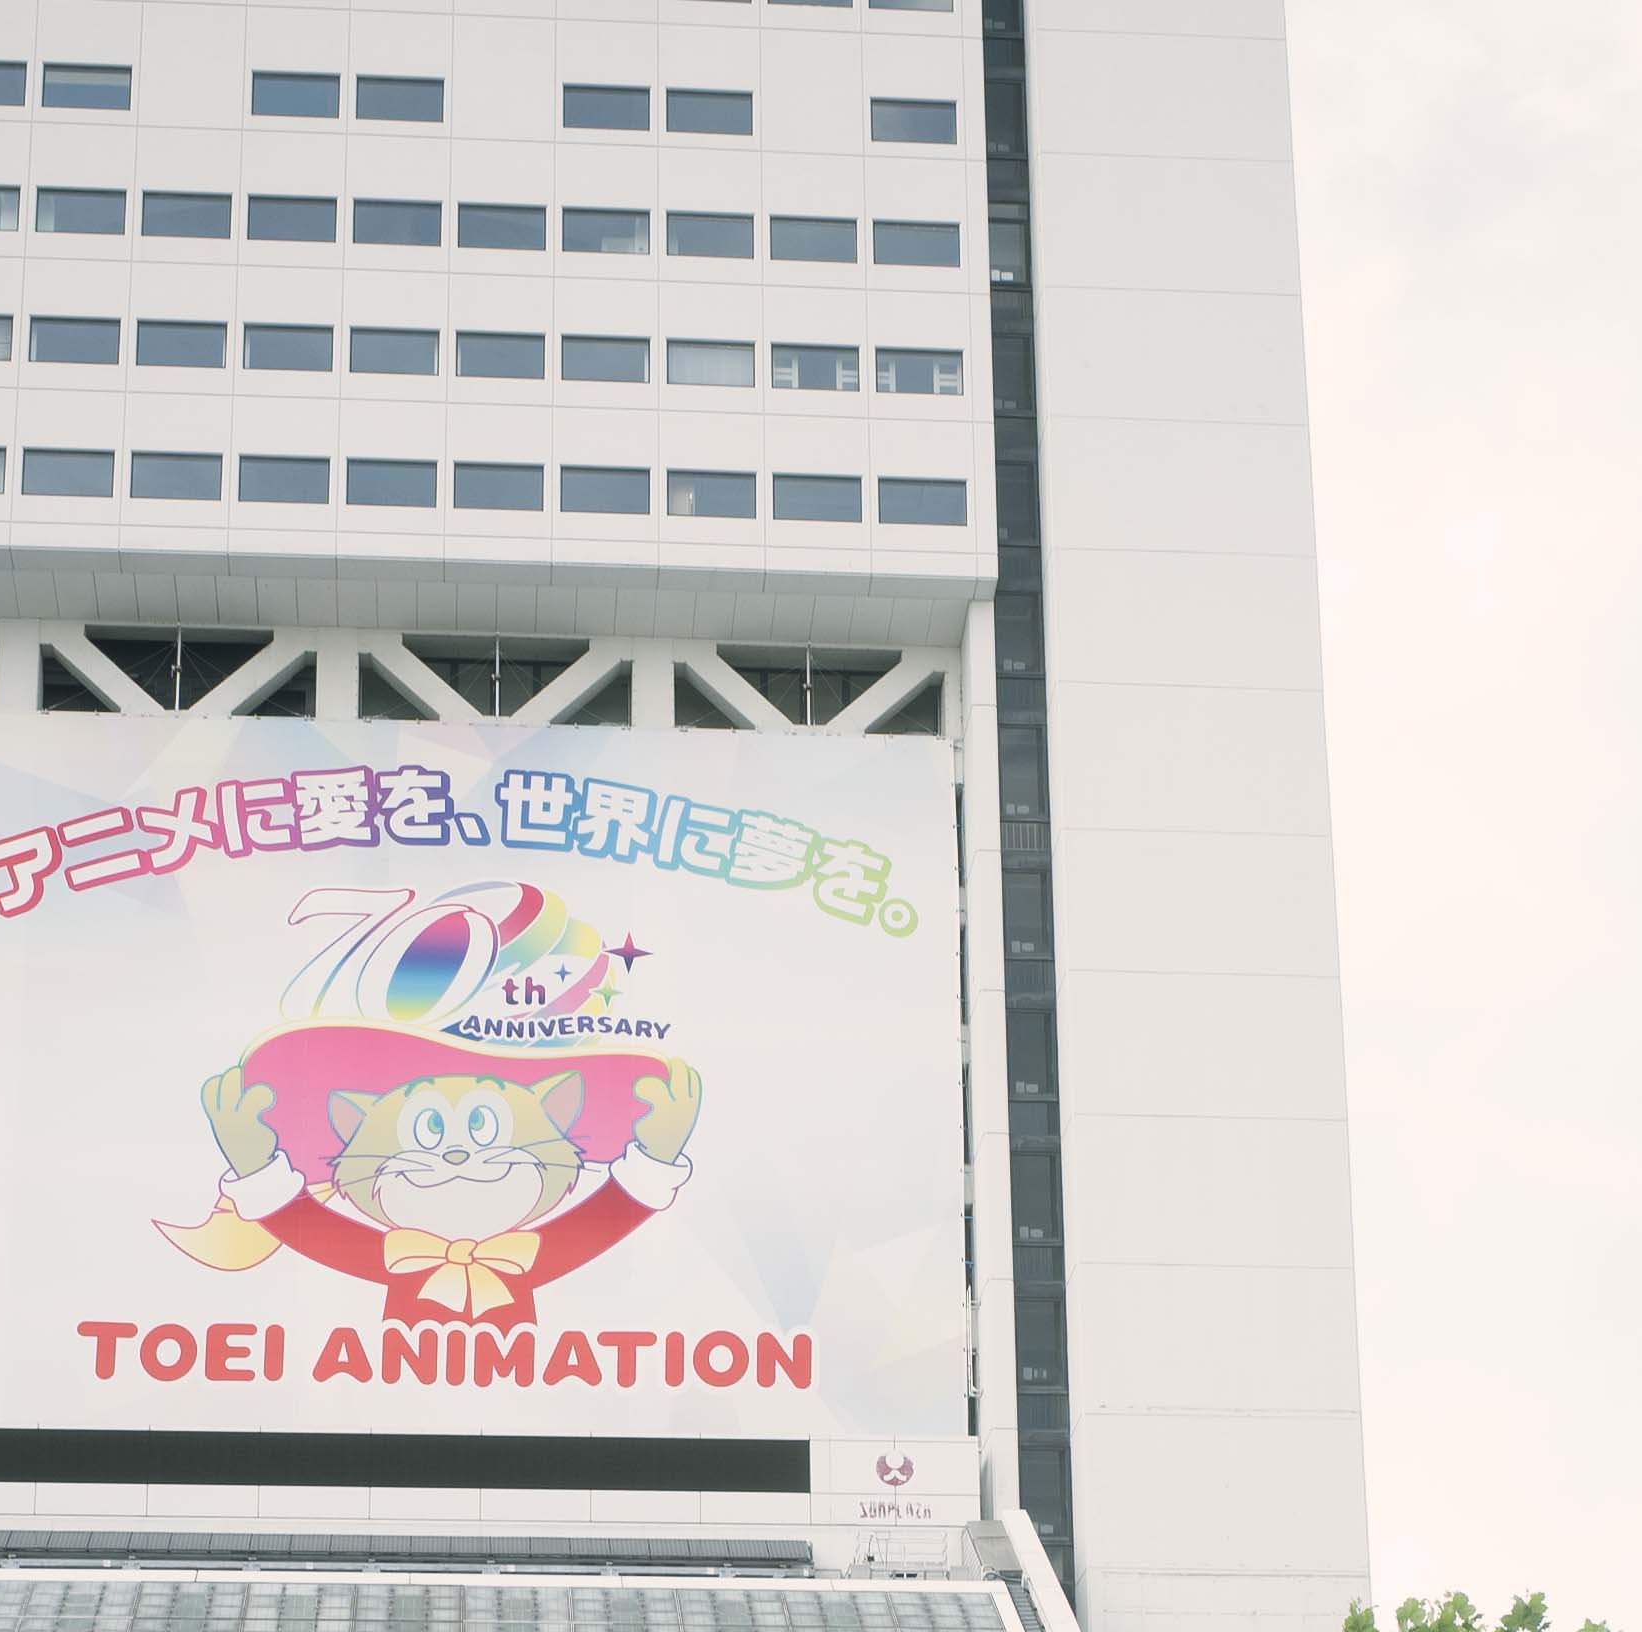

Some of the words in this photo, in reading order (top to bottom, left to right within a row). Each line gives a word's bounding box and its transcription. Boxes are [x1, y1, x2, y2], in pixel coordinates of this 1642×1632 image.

[278, 887, 499, 1021] 70
[502, 976, 546, 1006] th
[462, 1014, 672, 1041] ANNIVERSARY
[76, 1321, 287, 1382] TOEI
[312, 1327, 813, 1389] ANIMATION
